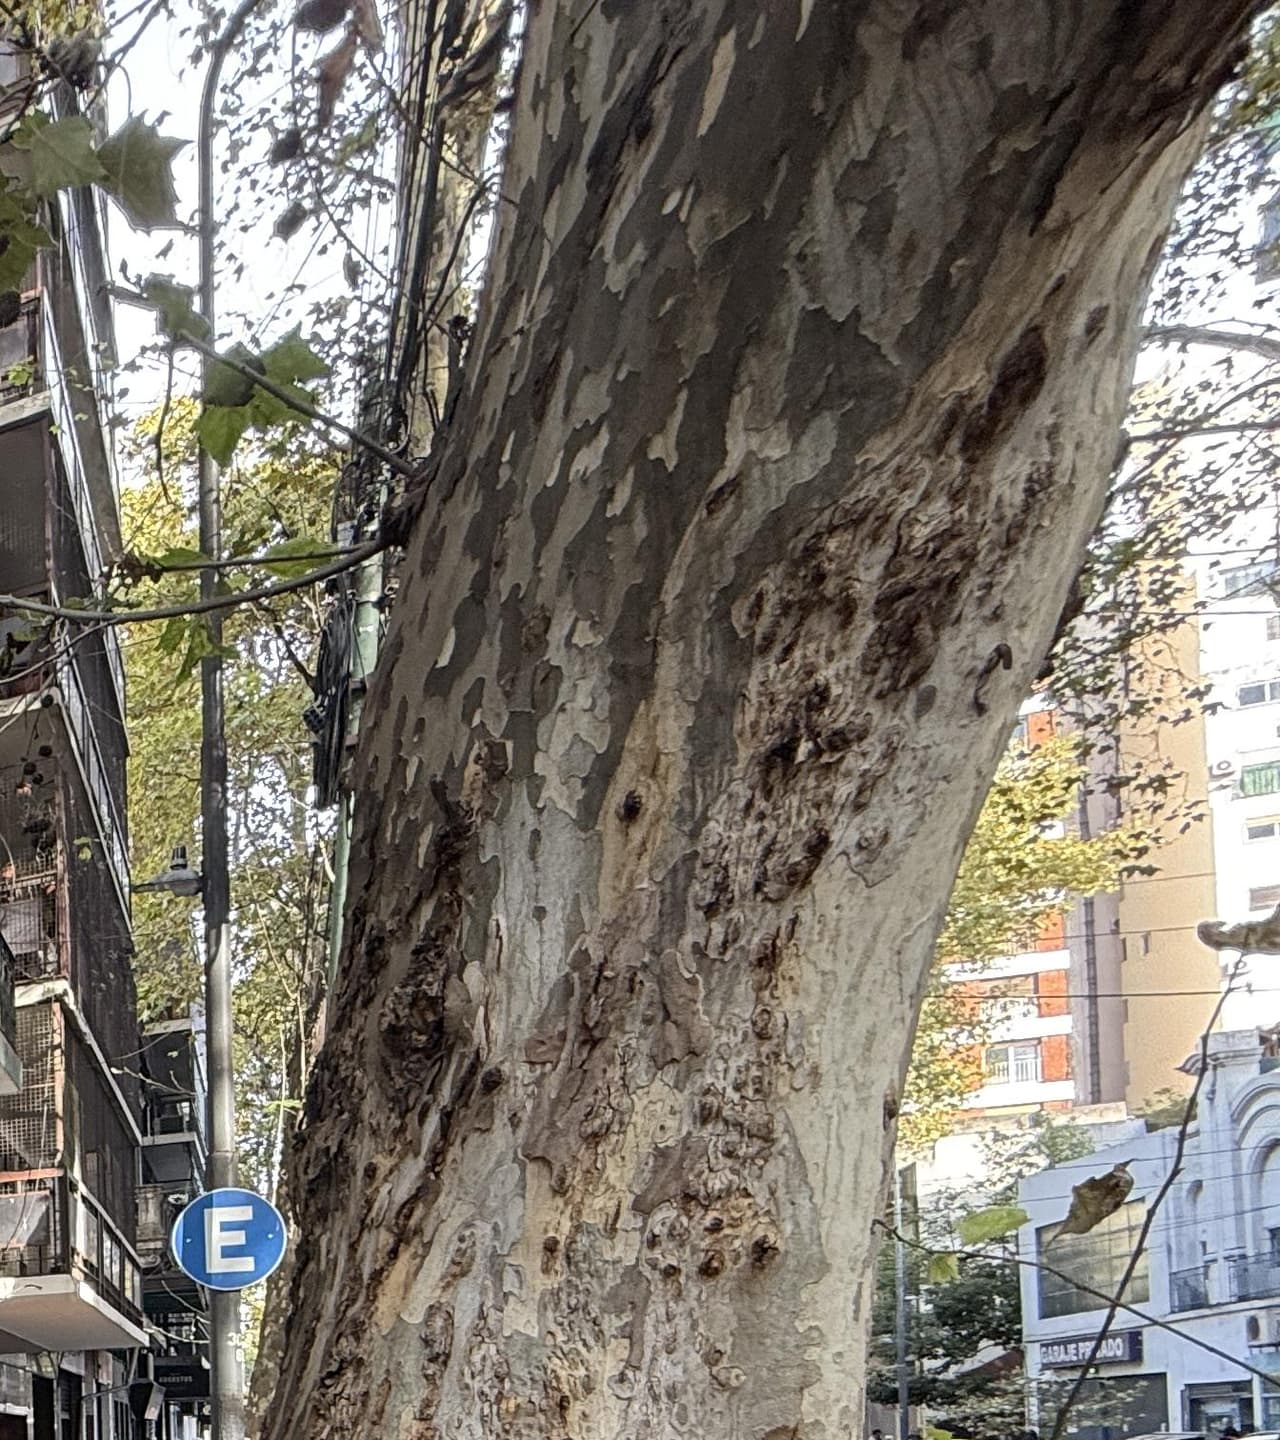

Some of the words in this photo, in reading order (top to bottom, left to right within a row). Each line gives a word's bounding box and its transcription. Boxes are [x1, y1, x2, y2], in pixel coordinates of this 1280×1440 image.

[204, 1205, 256, 1274] E
[1040, 1343, 1077, 1363] GARAJE
[1078, 1338, 1124, 1360] PRADO
